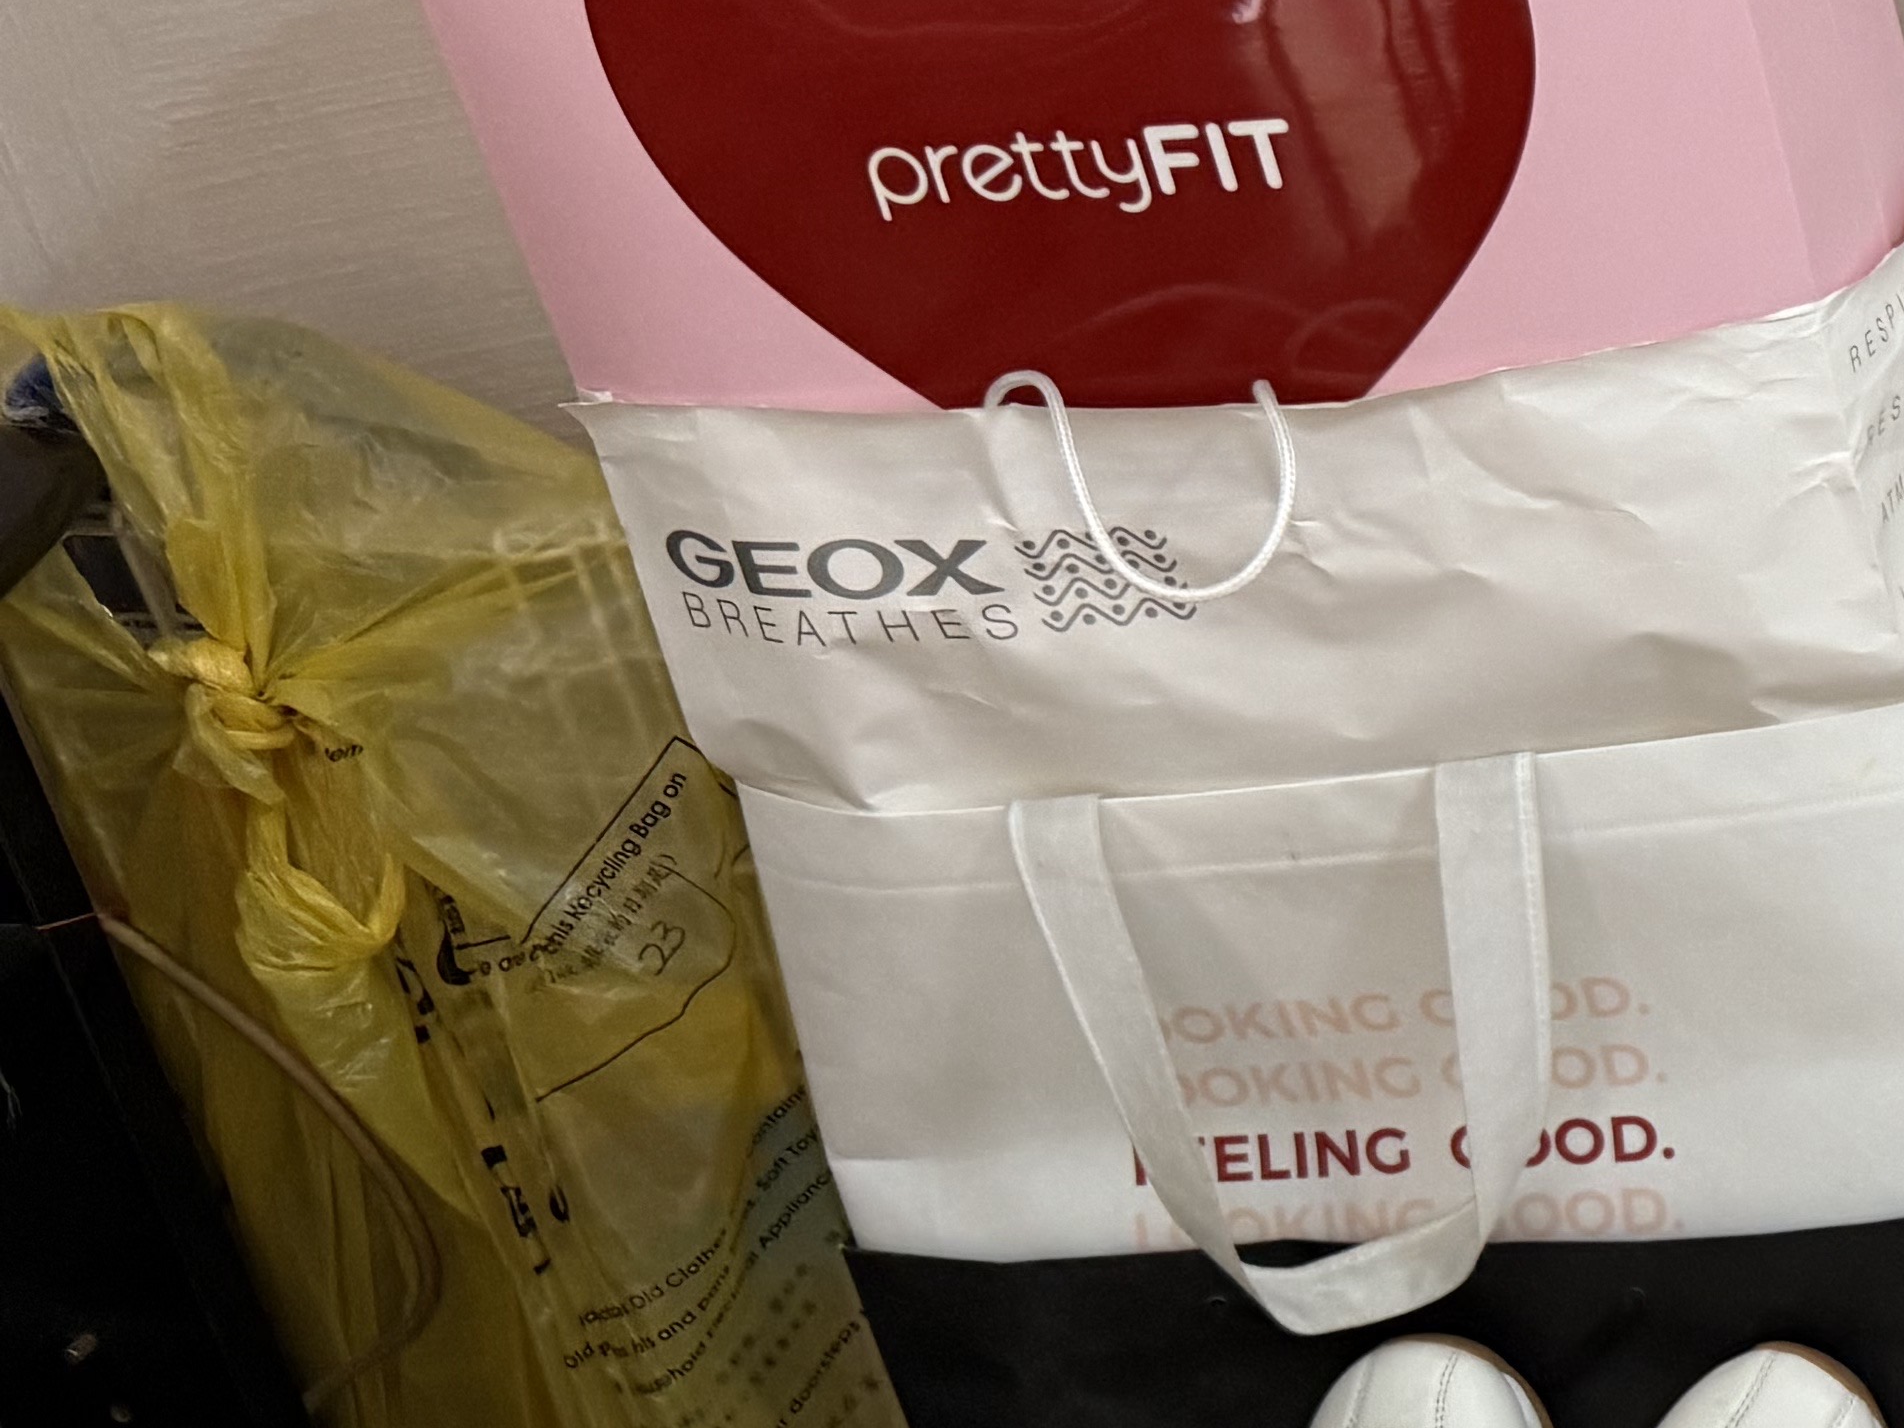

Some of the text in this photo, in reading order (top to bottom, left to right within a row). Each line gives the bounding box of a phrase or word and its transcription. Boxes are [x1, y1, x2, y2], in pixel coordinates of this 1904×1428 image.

[867, 118, 1290, 221] prettyFIT
[665, 530, 1006, 601] GEOX
[681, 590, 1019, 647] BREATHES
[628, 800, 672, 840] Bag
[662, 772, 687, 799] on
[637, 920, 686, 977] 23
[1162, 976, 1651, 1044] OKING GOD.
[1184, 1044, 1668, 1110] OKING OD.
[785, 1126, 822, 1167] Toy
[1133, 1114, 1676, 1185] ELING OD.
[1136, 1187, 1687, 1247] LOKING OOD.
[657, 1308, 699, 1343] and
